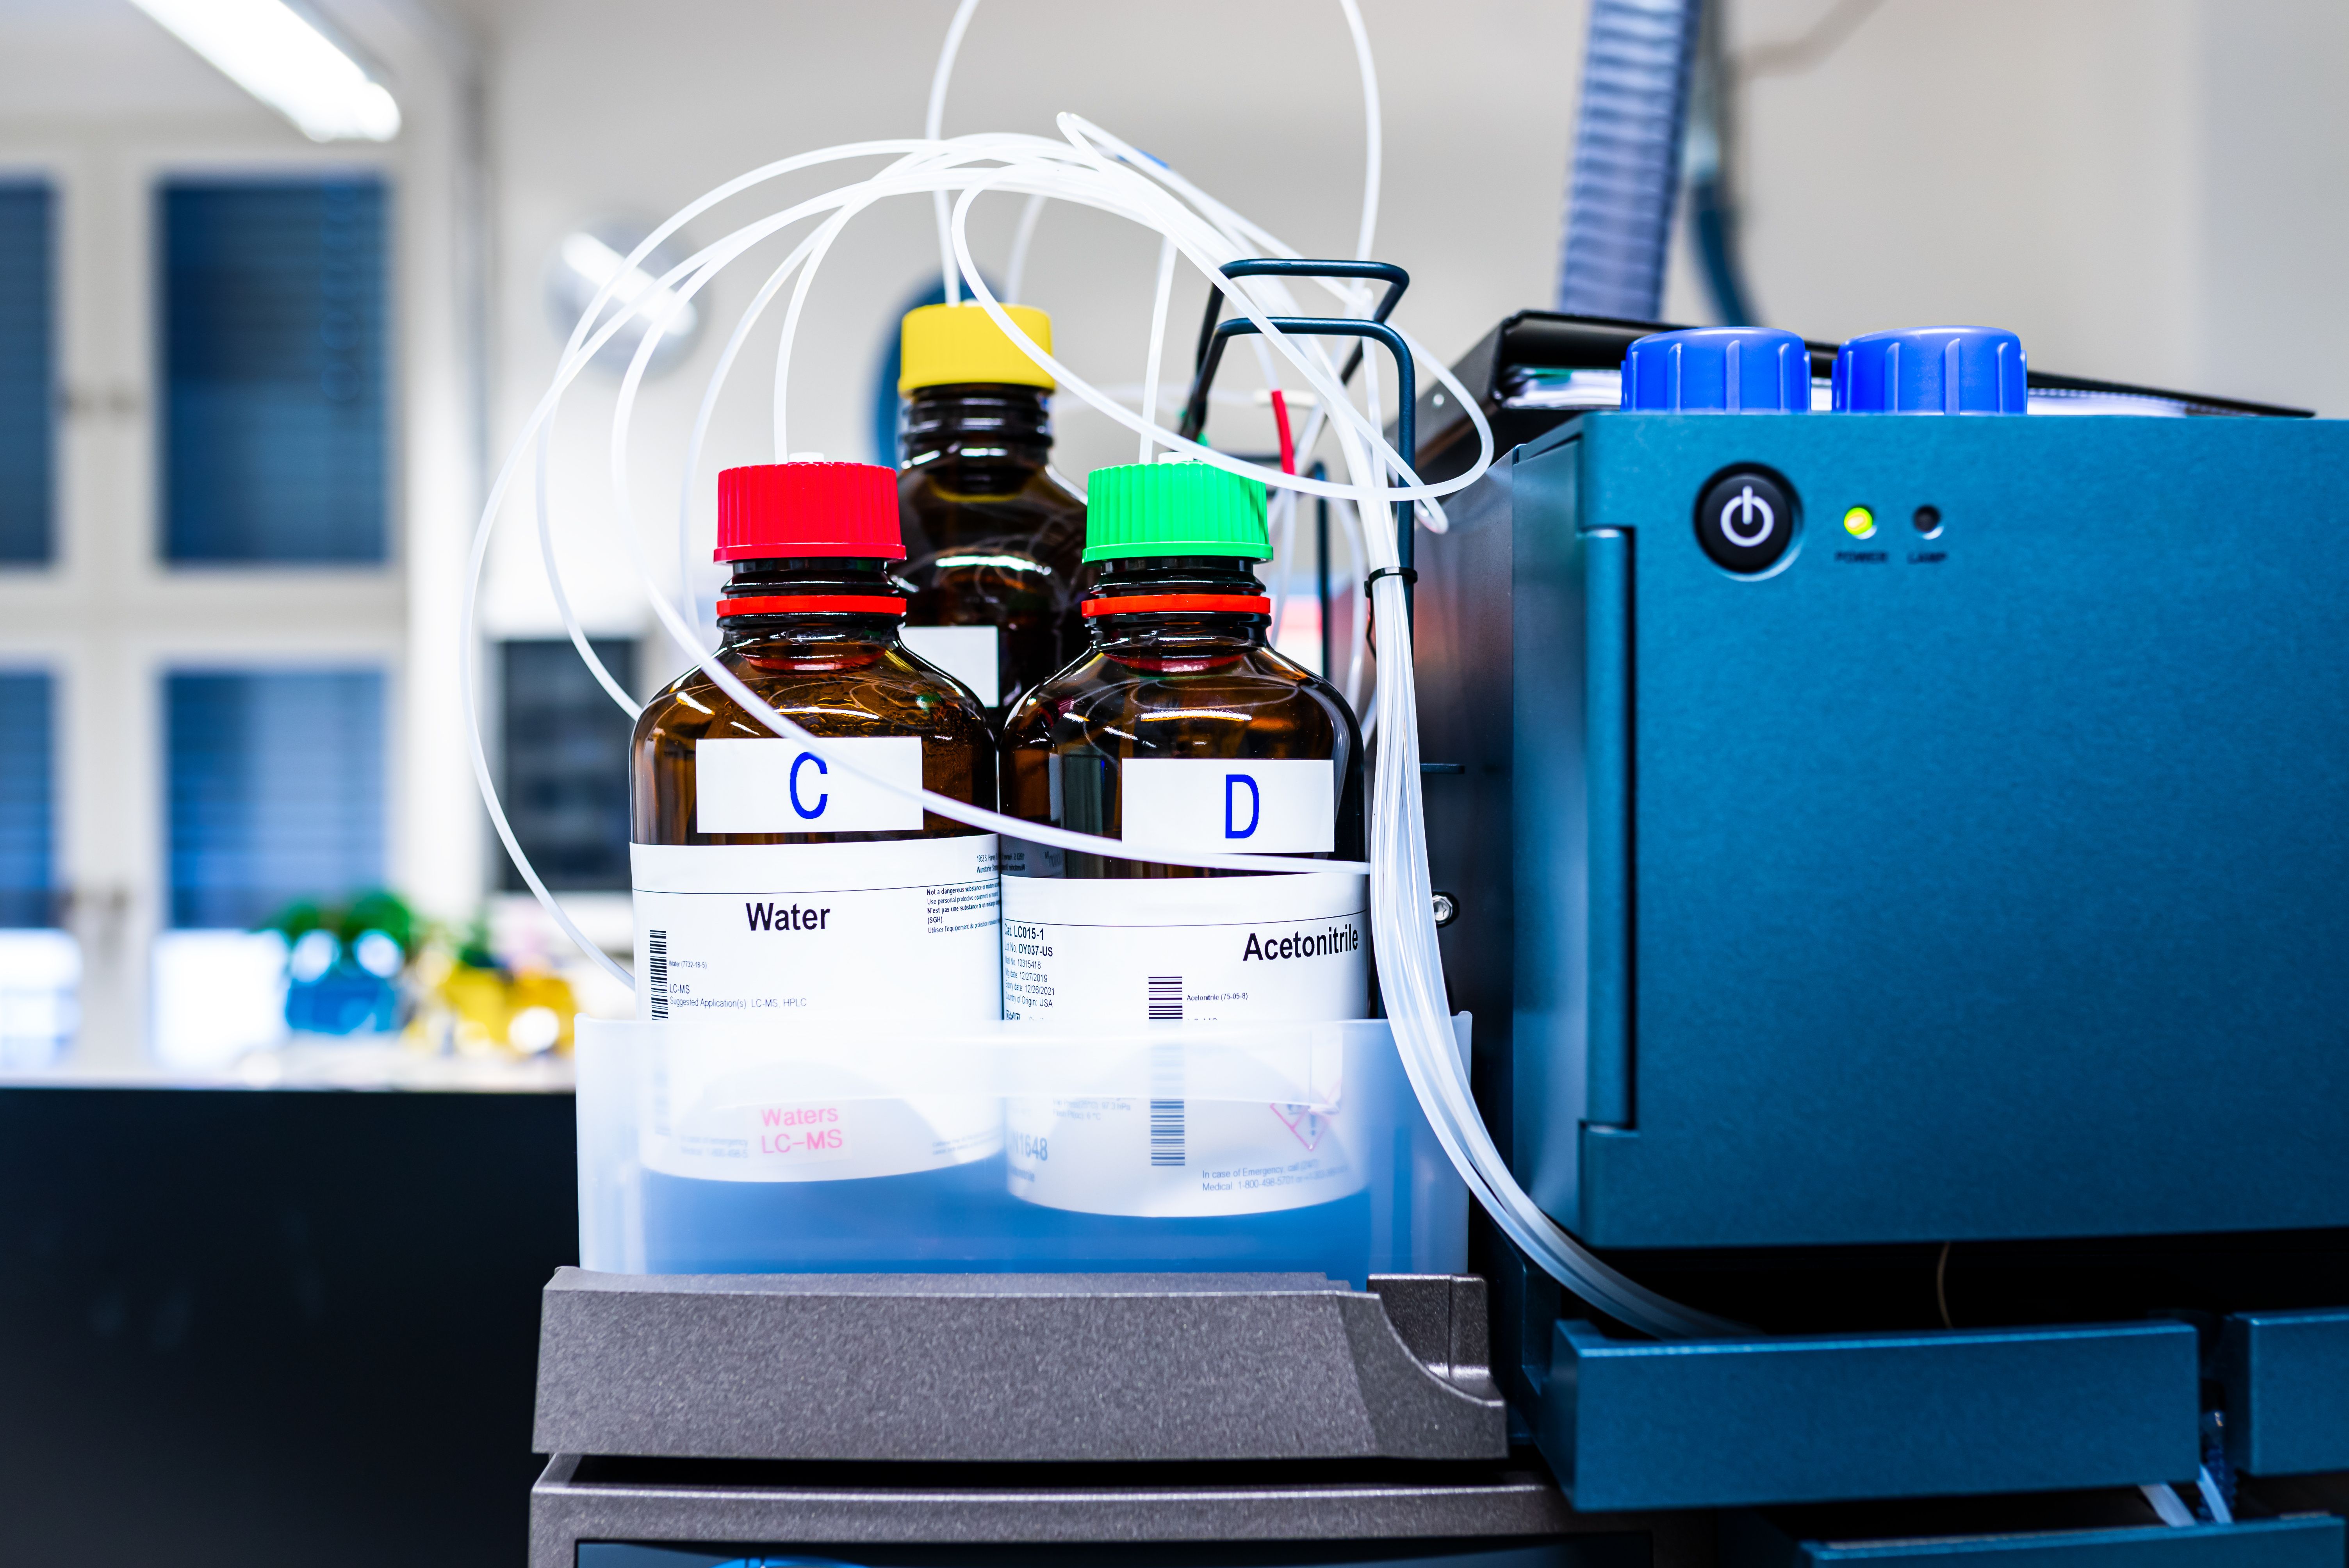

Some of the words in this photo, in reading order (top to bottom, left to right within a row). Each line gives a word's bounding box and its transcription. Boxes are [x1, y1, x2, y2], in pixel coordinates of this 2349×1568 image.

[790, 752, 828, 819] C
[1225, 774, 1259, 839] D
[938, 896, 956, 905] personal
[957, 895, 973, 903] protective
[745, 902, 831, 931] Water
[928, 916, 944, 925] (SGH).
[1014, 925, 1044, 940] LC015-1
[1242, 923, 1358, 961] Acetonitrile
[1019, 943, 1053, 957] DY037-US
[681, 960, 707, 969] (7732-18-5)
[1018, 959, 1041, 969] 10315418
[1020, 971, 1048, 983] 12/27/2019
[670, 984, 690, 994] LC-MS
[1025, 984, 1055, 996] 12/26/2021
[670, 996, 699, 1007] Suggested
[783, 998, 807, 1007] HPLC
[1022, 996, 1037, 1007] Origin:
[1039, 998, 1053, 1008] USA
[1221, 993, 1248, 1001] (75-05-8)
[761, 1108, 839, 1127] Waters
[761, 1129, 843, 1154] LC-MS
[1203, 1170, 1210, 1179] In
[1233, 1168, 1241, 1177] of
